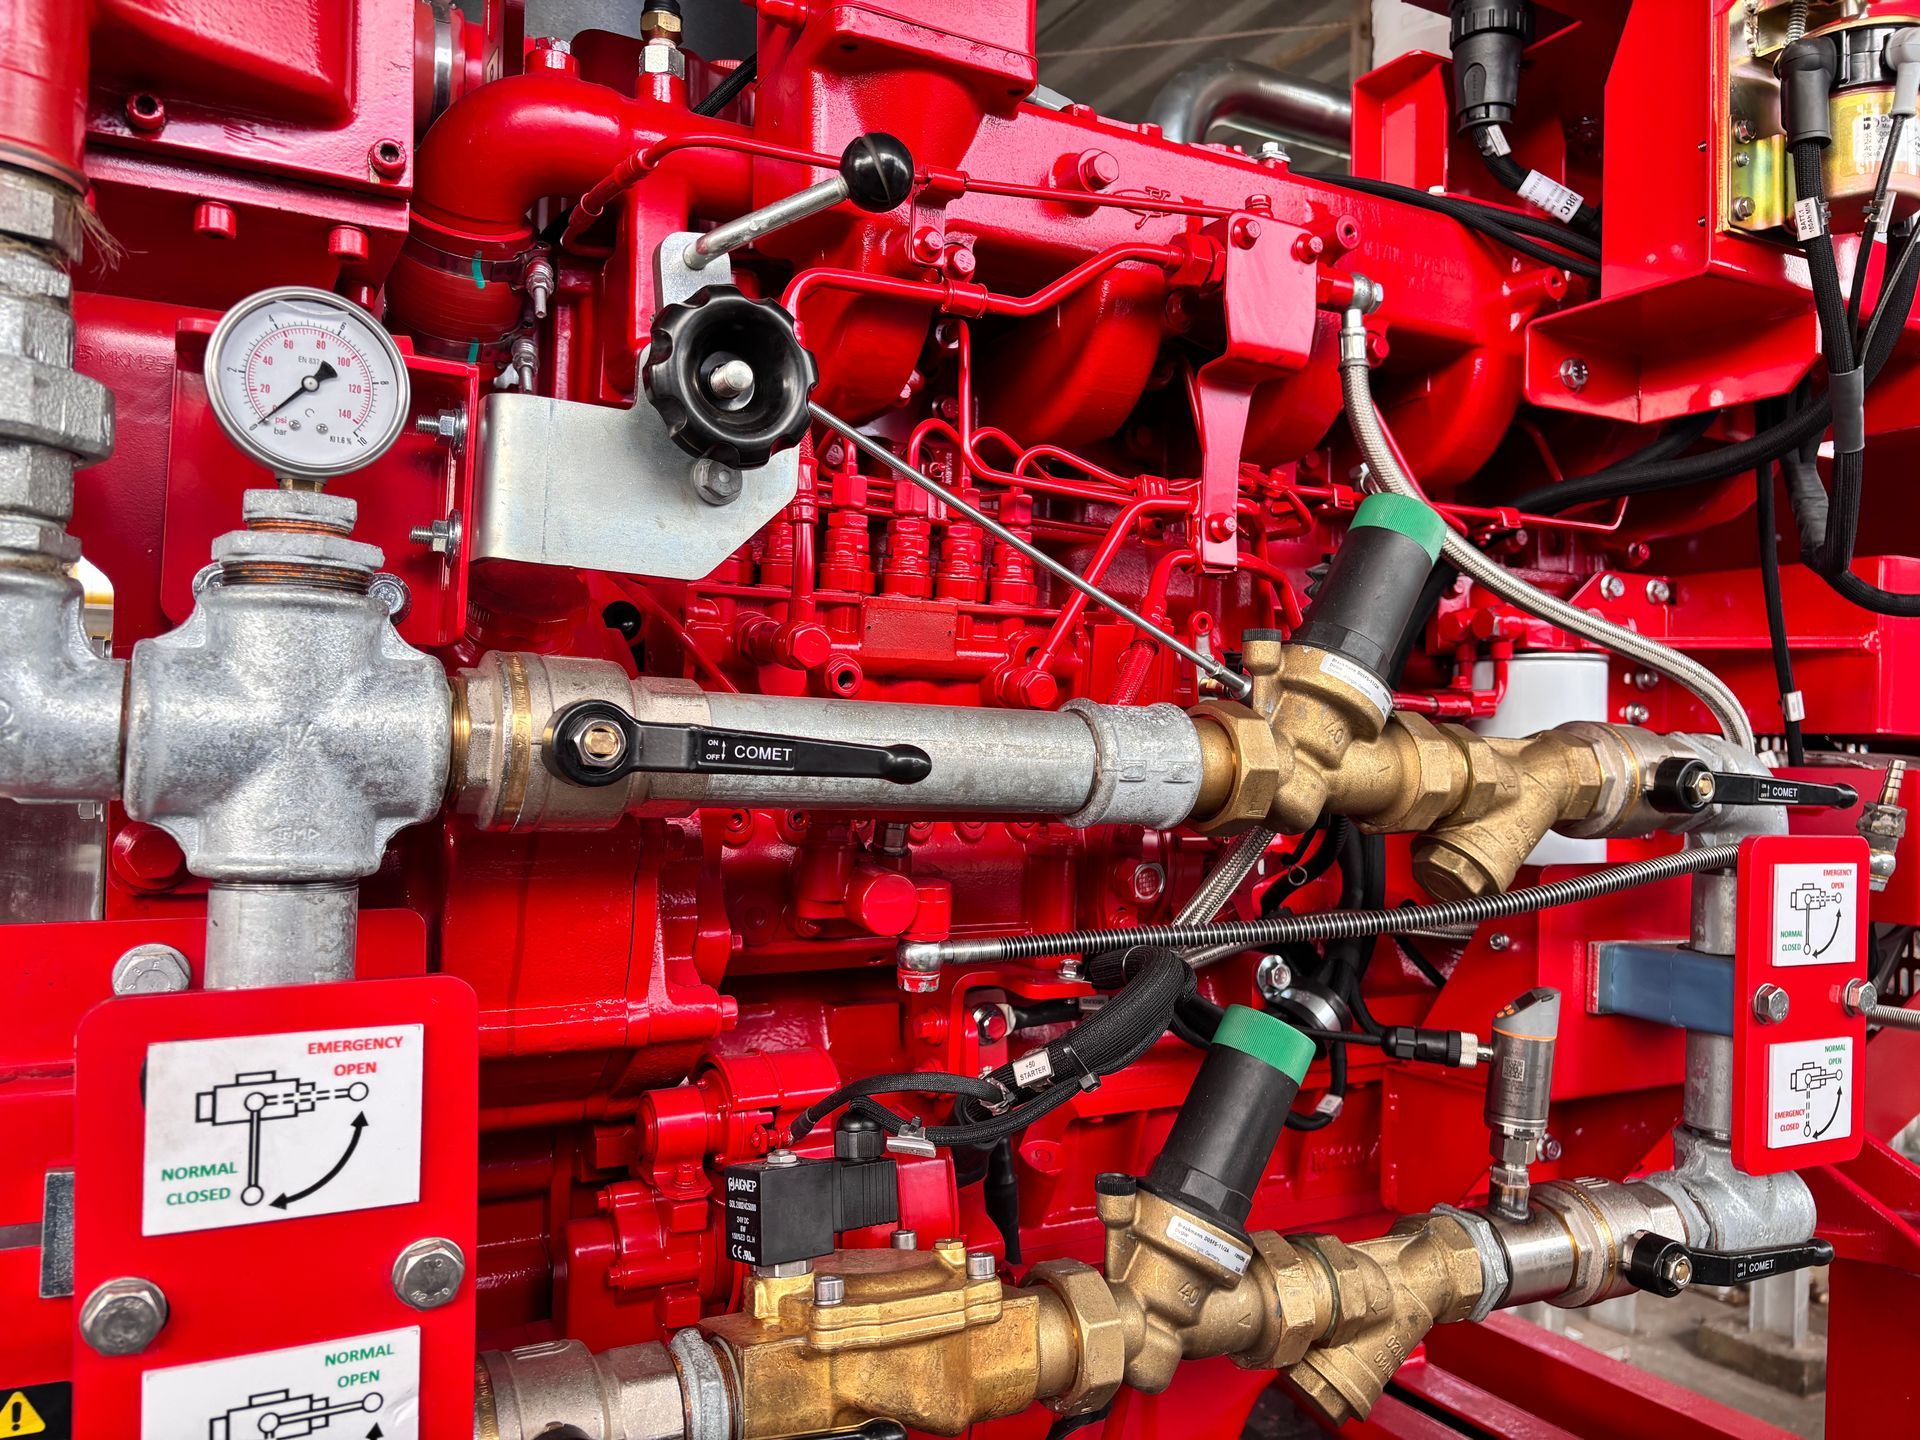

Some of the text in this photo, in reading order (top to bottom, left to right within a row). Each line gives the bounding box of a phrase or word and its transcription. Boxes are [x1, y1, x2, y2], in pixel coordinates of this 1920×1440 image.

[283, 339, 294, 350] 60
[316, 339, 326, 350] 80
[262, 356, 273, 366] 40
[298, 356, 308, 364] EN
[337, 356, 351, 368] 100
[260, 384, 270, 394] 20
[349, 384, 362, 394] 120
[338, 408, 352, 419] 140
[275, 416, 287, 424] psi
[274, 427, 287, 436] bar
[336, 436, 345, 444] 1.6
[357, 437, 368, 446] 10
[734, 745, 792, 761] COMET
[1772, 786, 1798, 797] COMET
[1780, 930, 1803, 938] NORMAL
[307, 1036, 404, 1054] EMERGENCY
[1824, 1044, 1846, 1053] NORMAL
[1026, 1060, 1036, 1069] +50
[1828, 1058, 1842, 1066] OPEN
[334, 1062, 377, 1076] OPEN
[1020, 1066, 1047, 1080] STARTER
[1774, 1108, 1806, 1119] EMERGENCY
[1780, 1123, 1799, 1132] CLOSED
[161, 1162, 238, 1181] NORMAL
[734, 1178, 757, 1192] AIGNEP
[166, 1188, 231, 1206] CLOSED
[1749, 1259, 1774, 1273] COMET
[325, 1344, 395, 1367] NORMAL
[337, 1369, 380, 1388] OPEN
